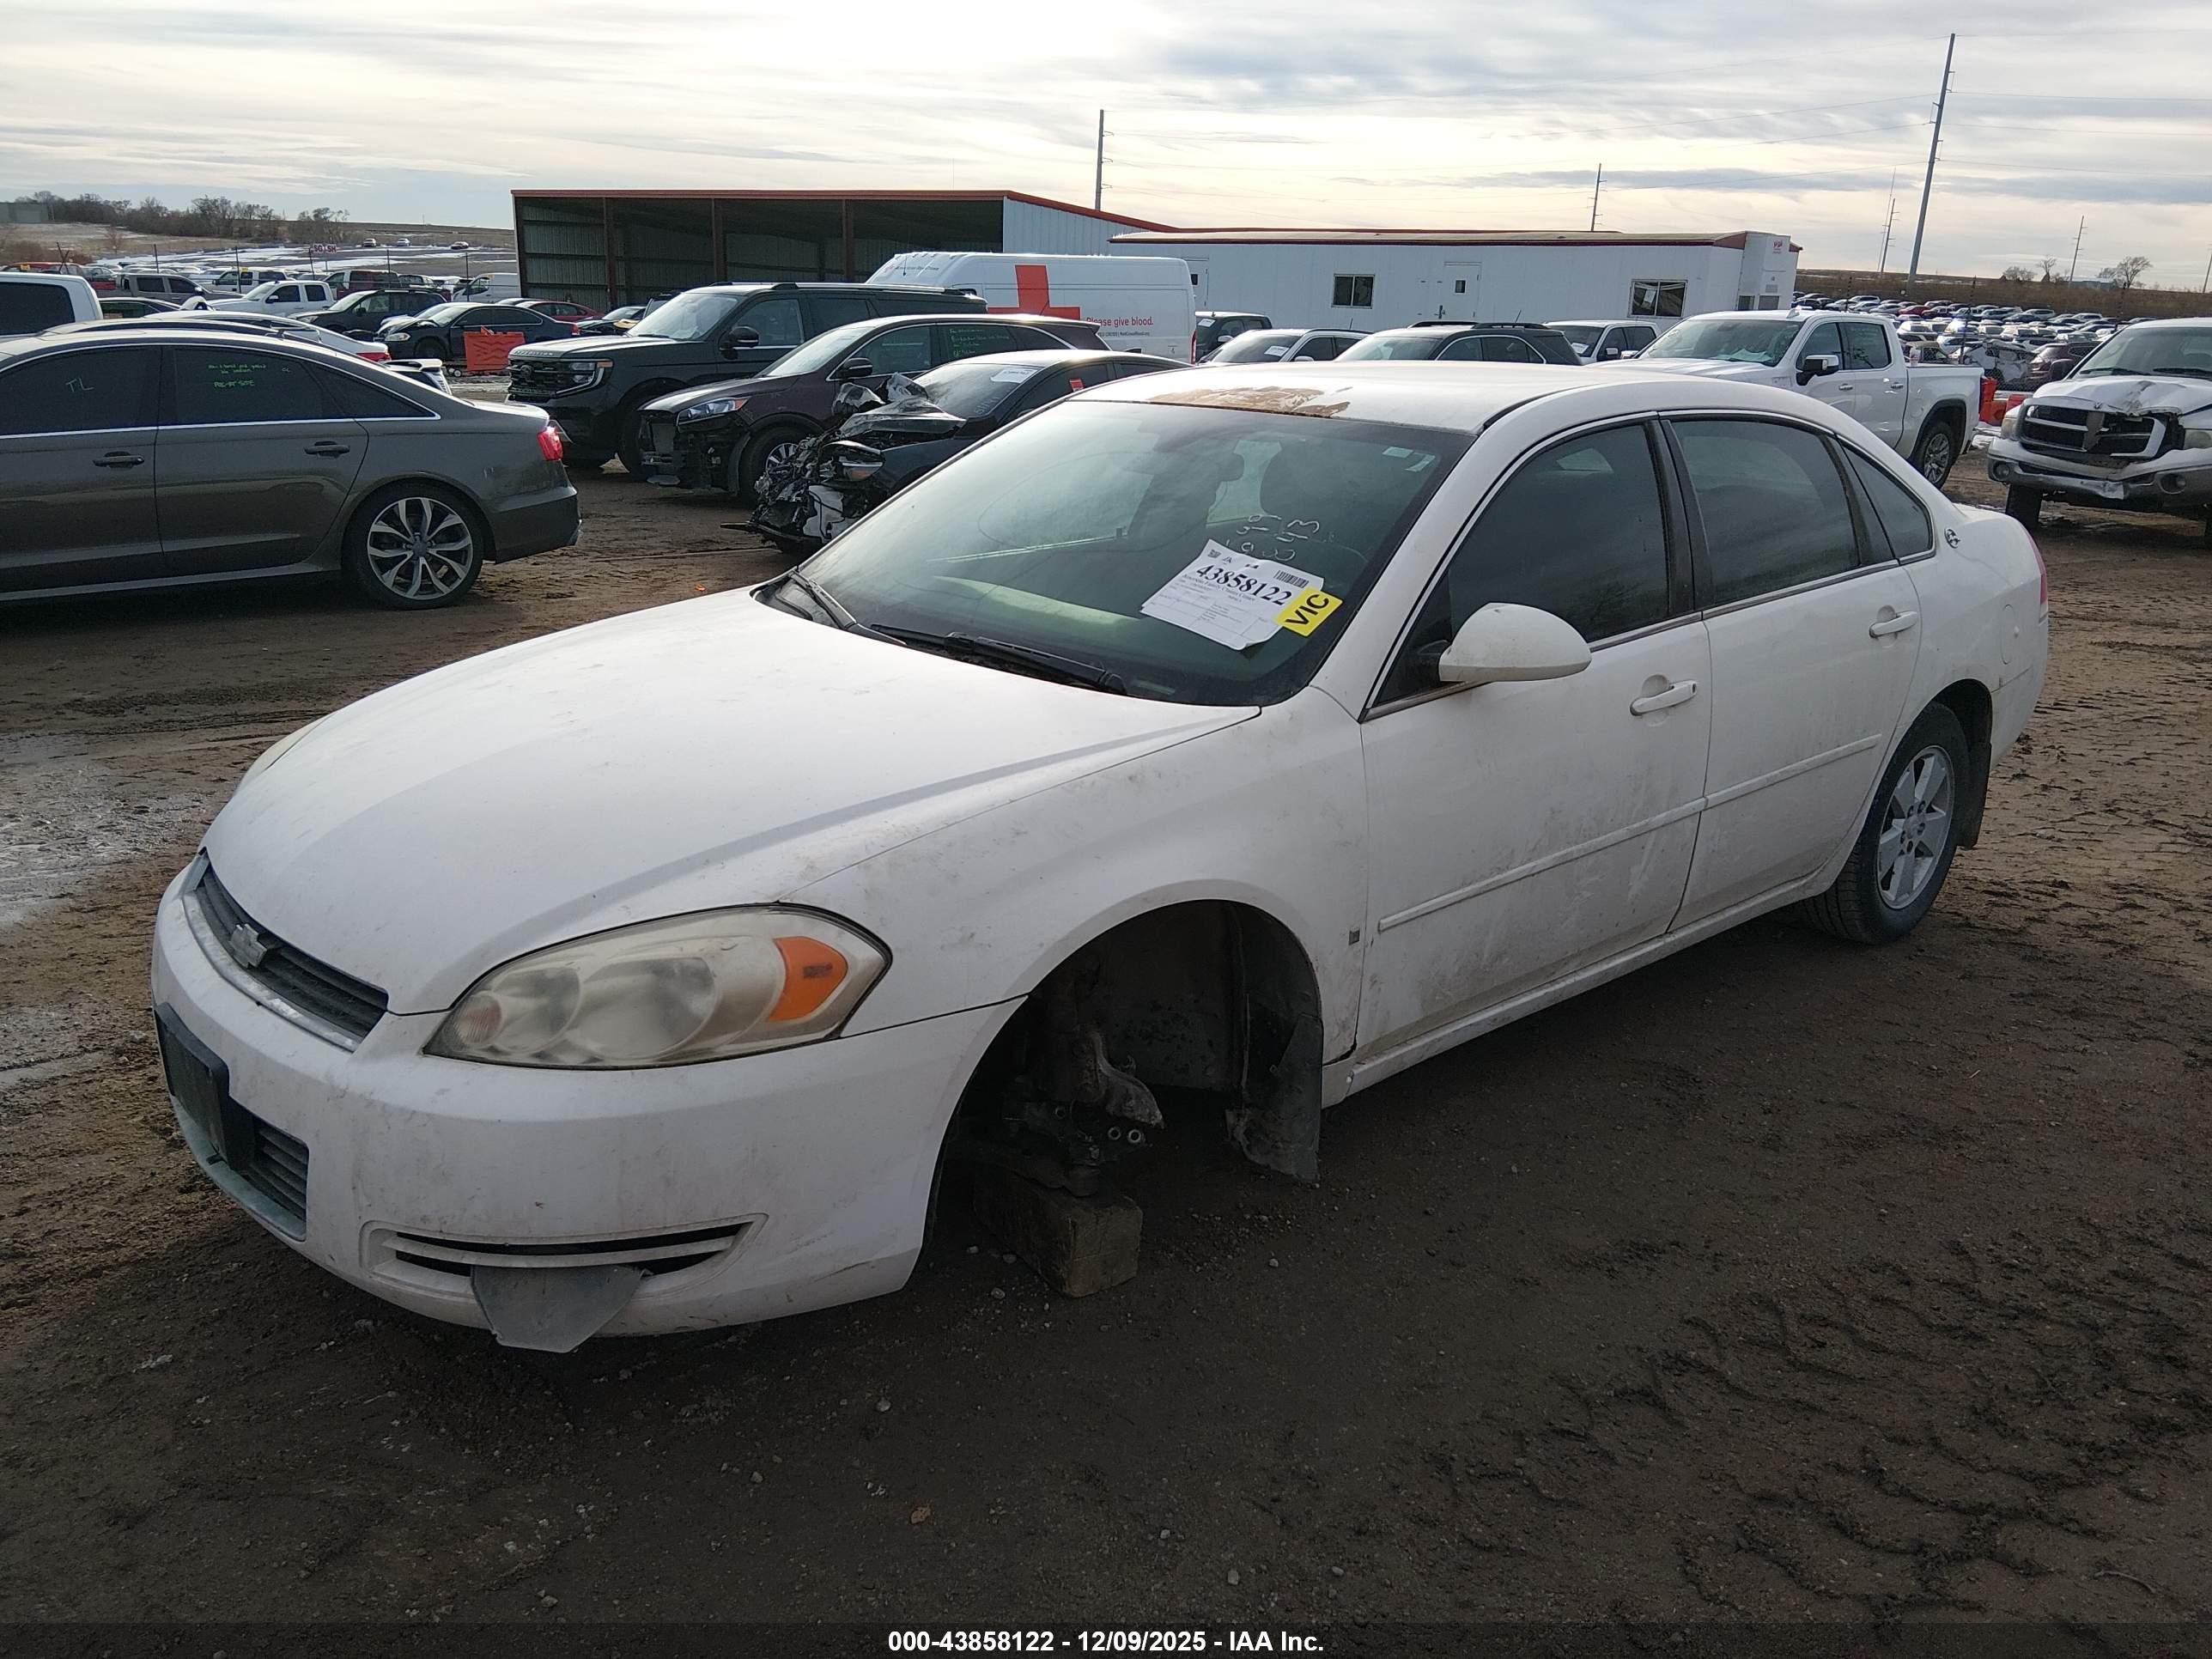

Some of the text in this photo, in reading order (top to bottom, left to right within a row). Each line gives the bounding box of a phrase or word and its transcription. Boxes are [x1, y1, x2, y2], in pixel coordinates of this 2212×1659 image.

[1114, 317, 1129, 327] give
[1131, 315, 1154, 326] blood.
[1196, 564, 1292, 606] 43858122
[1284, 593, 1330, 626] VIC
